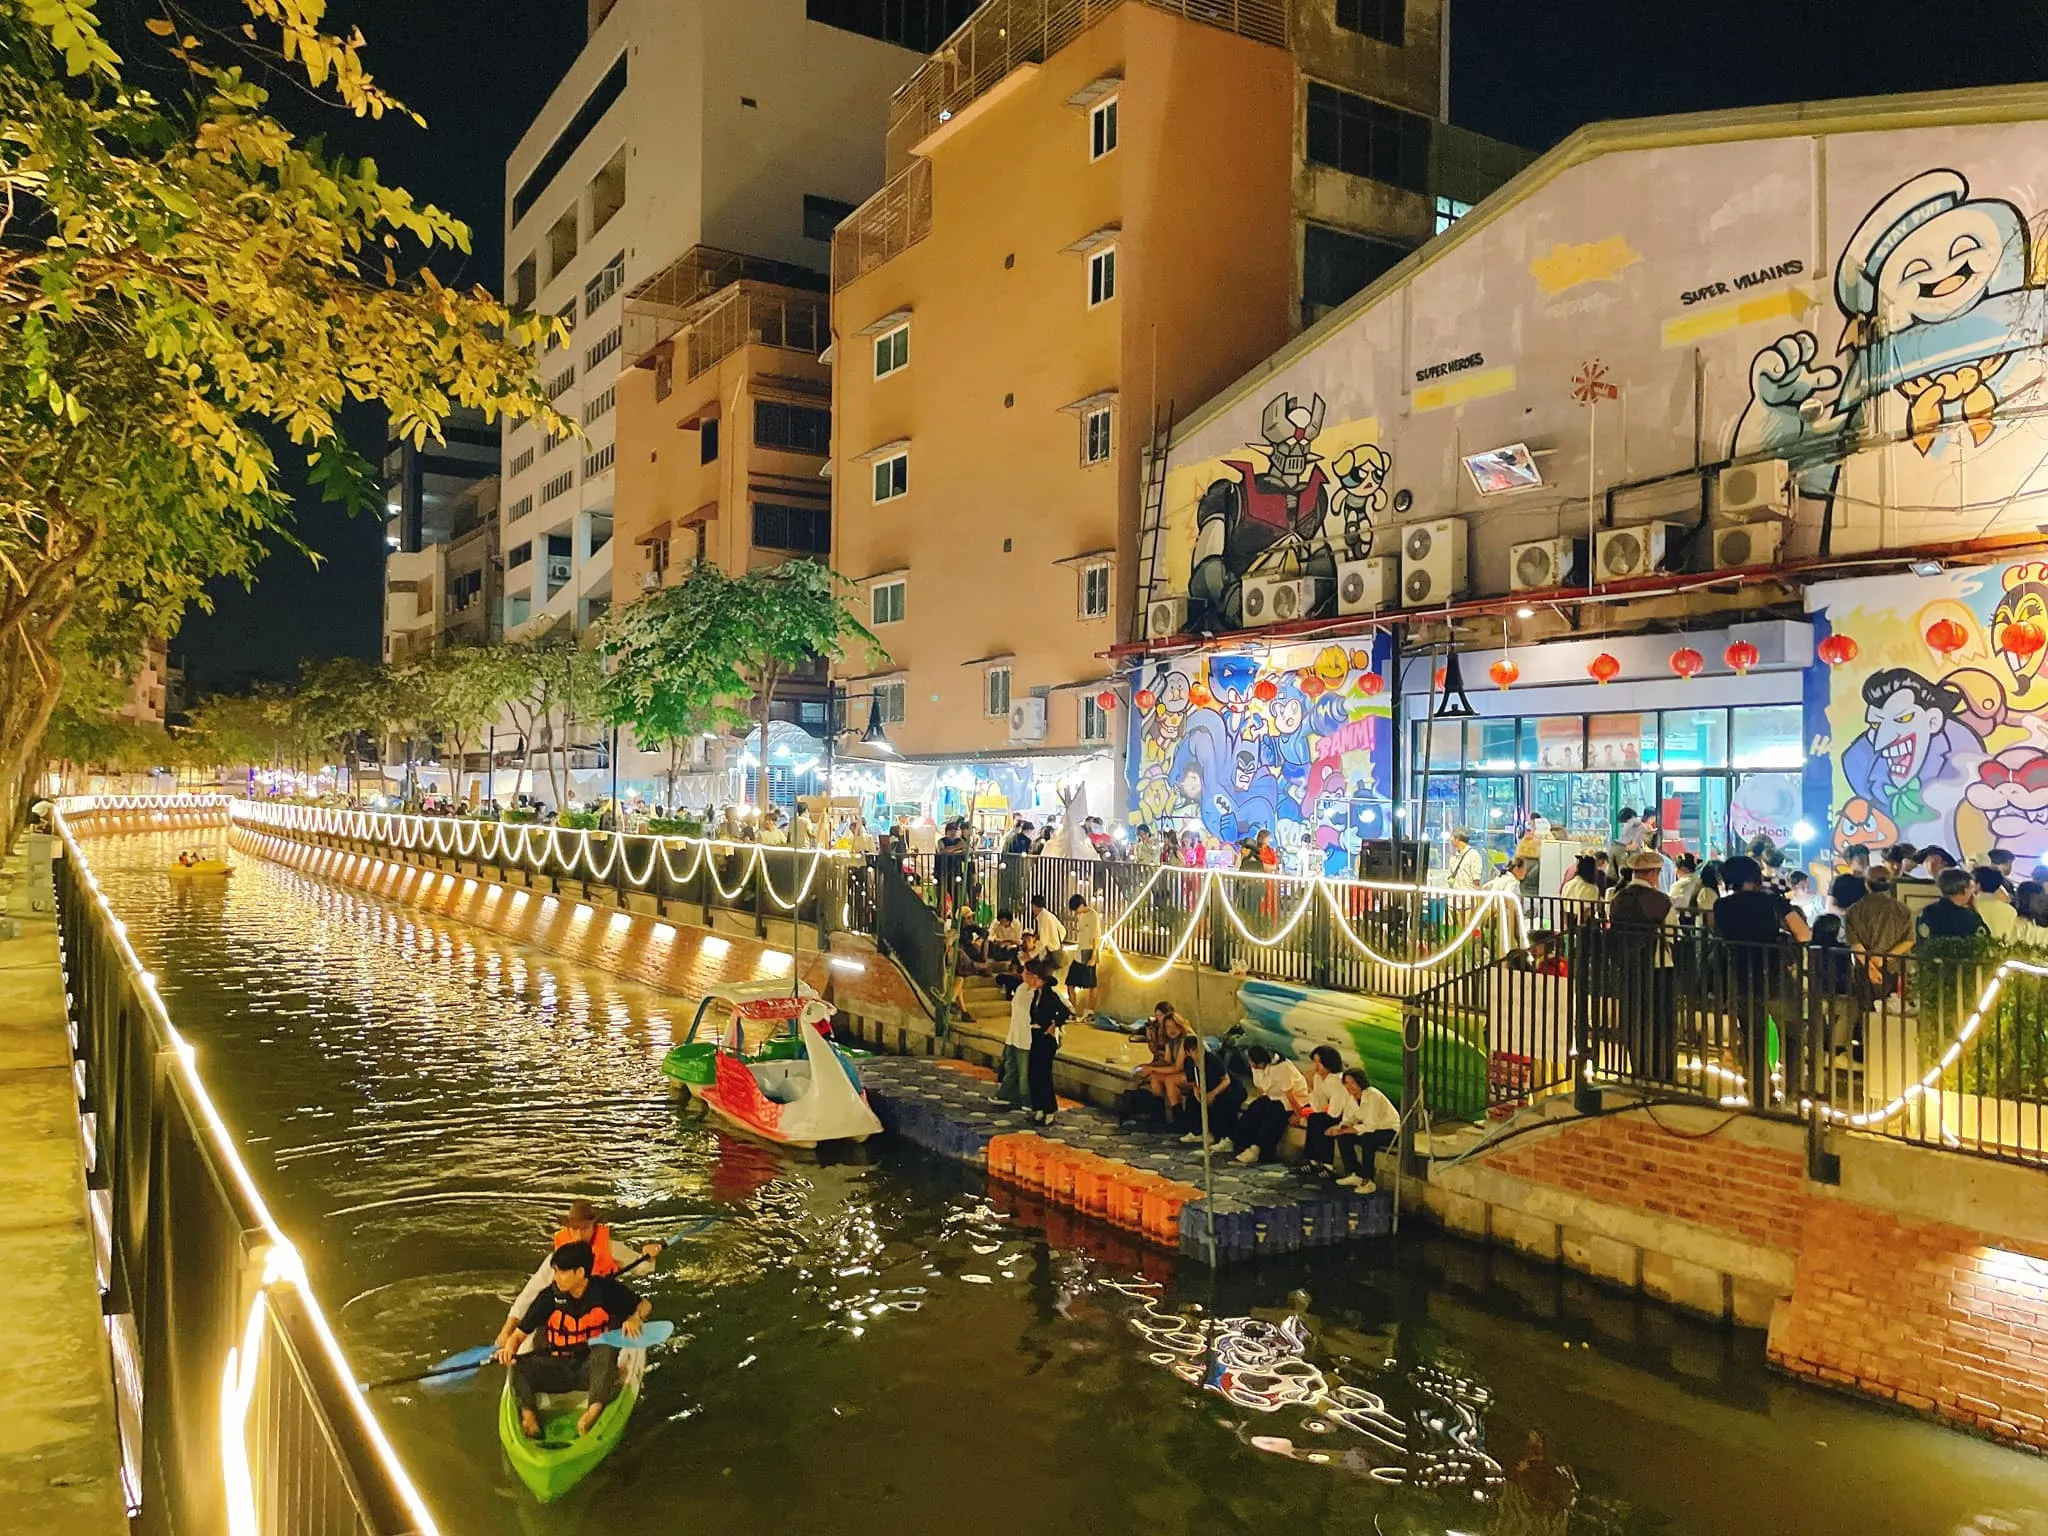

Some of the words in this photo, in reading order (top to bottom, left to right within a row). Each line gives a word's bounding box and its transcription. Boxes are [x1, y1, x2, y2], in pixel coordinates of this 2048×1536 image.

[1876, 220, 1908, 257] STAY
[1680, 282, 1730, 305] SUPER
[1733, 260, 1804, 290] VILLAINS
